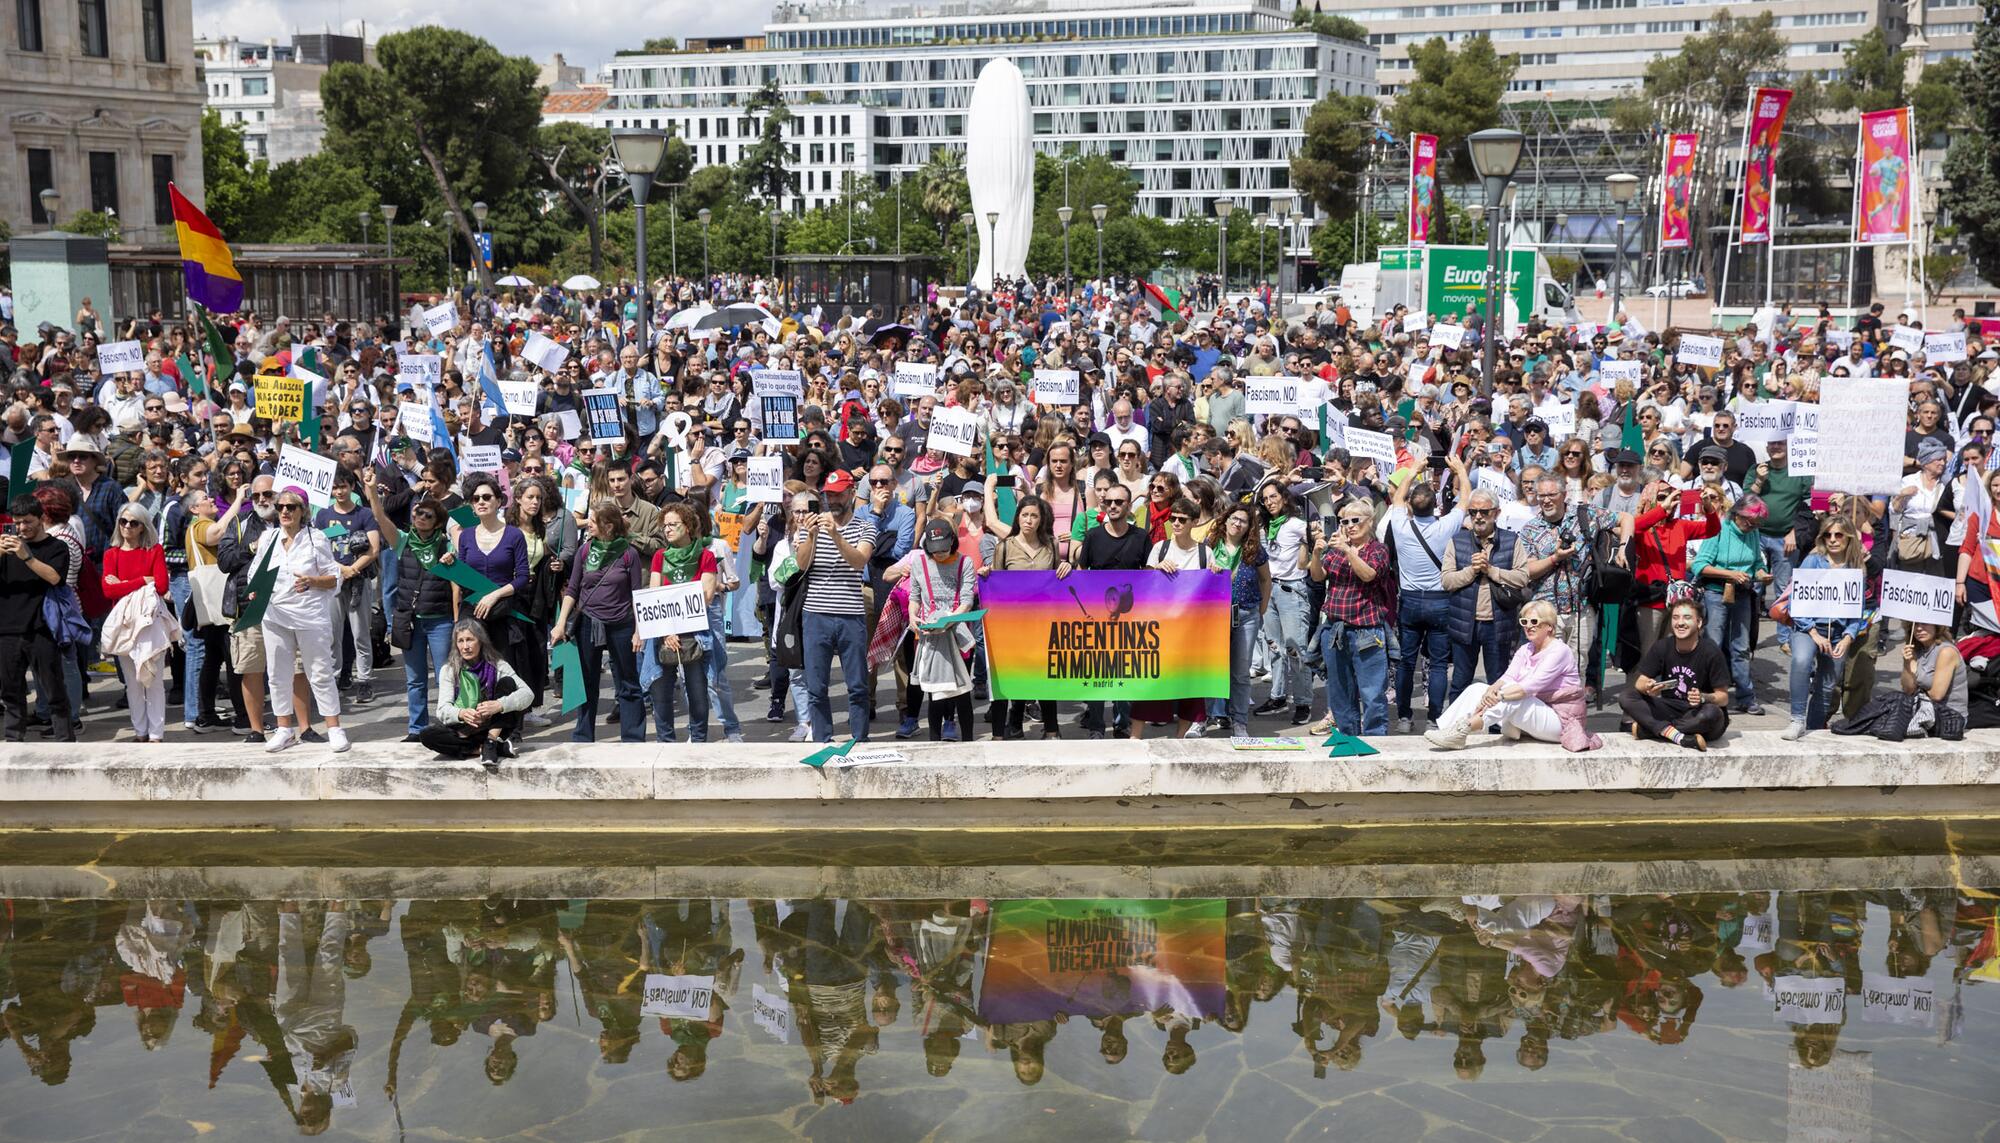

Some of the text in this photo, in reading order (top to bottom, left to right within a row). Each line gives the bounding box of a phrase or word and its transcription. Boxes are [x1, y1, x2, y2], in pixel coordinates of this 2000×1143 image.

[1443, 295, 1476, 304] moving
[100, 348, 142, 365] Fascismo, NO!
[1681, 341, 1720, 358] Fascismo, NO!
[755, 381, 768, 390] Diga
[896, 370, 935, 386] Fascismo, NO!
[1035, 377, 1078, 395] Fascismo, NO!
[256, 392, 300, 402] MASCOTAS
[522, 390, 535, 404] NO!
[1246, 386, 1298, 404] Fascismo, NO!
[268, 403, 299, 418] PODER
[930, 416, 976, 443] Fascismo, NO!
[1740, 412, 1779, 431] Fascismo,
[1780, 412, 1795, 428] NO!
[1791, 448, 1817, 458] Diga lo
[279, 456, 332, 492] Fascismo, NO!
[748, 468, 781, 487] Fascismo, NO!
[1793, 580, 1861, 603] Fascismo, NO!
[1883, 581, 1952, 610] Fascismo, NO!
[636, 593, 704, 622] Fascismo, NO!
[1048, 620, 1160, 650] ARGENTINXS
[1048, 650, 1160, 679] EN MOVIMIENTO
[1671, 666, 1696, 678] MI VOZ
[1093, 679, 1114, 689] madrid
